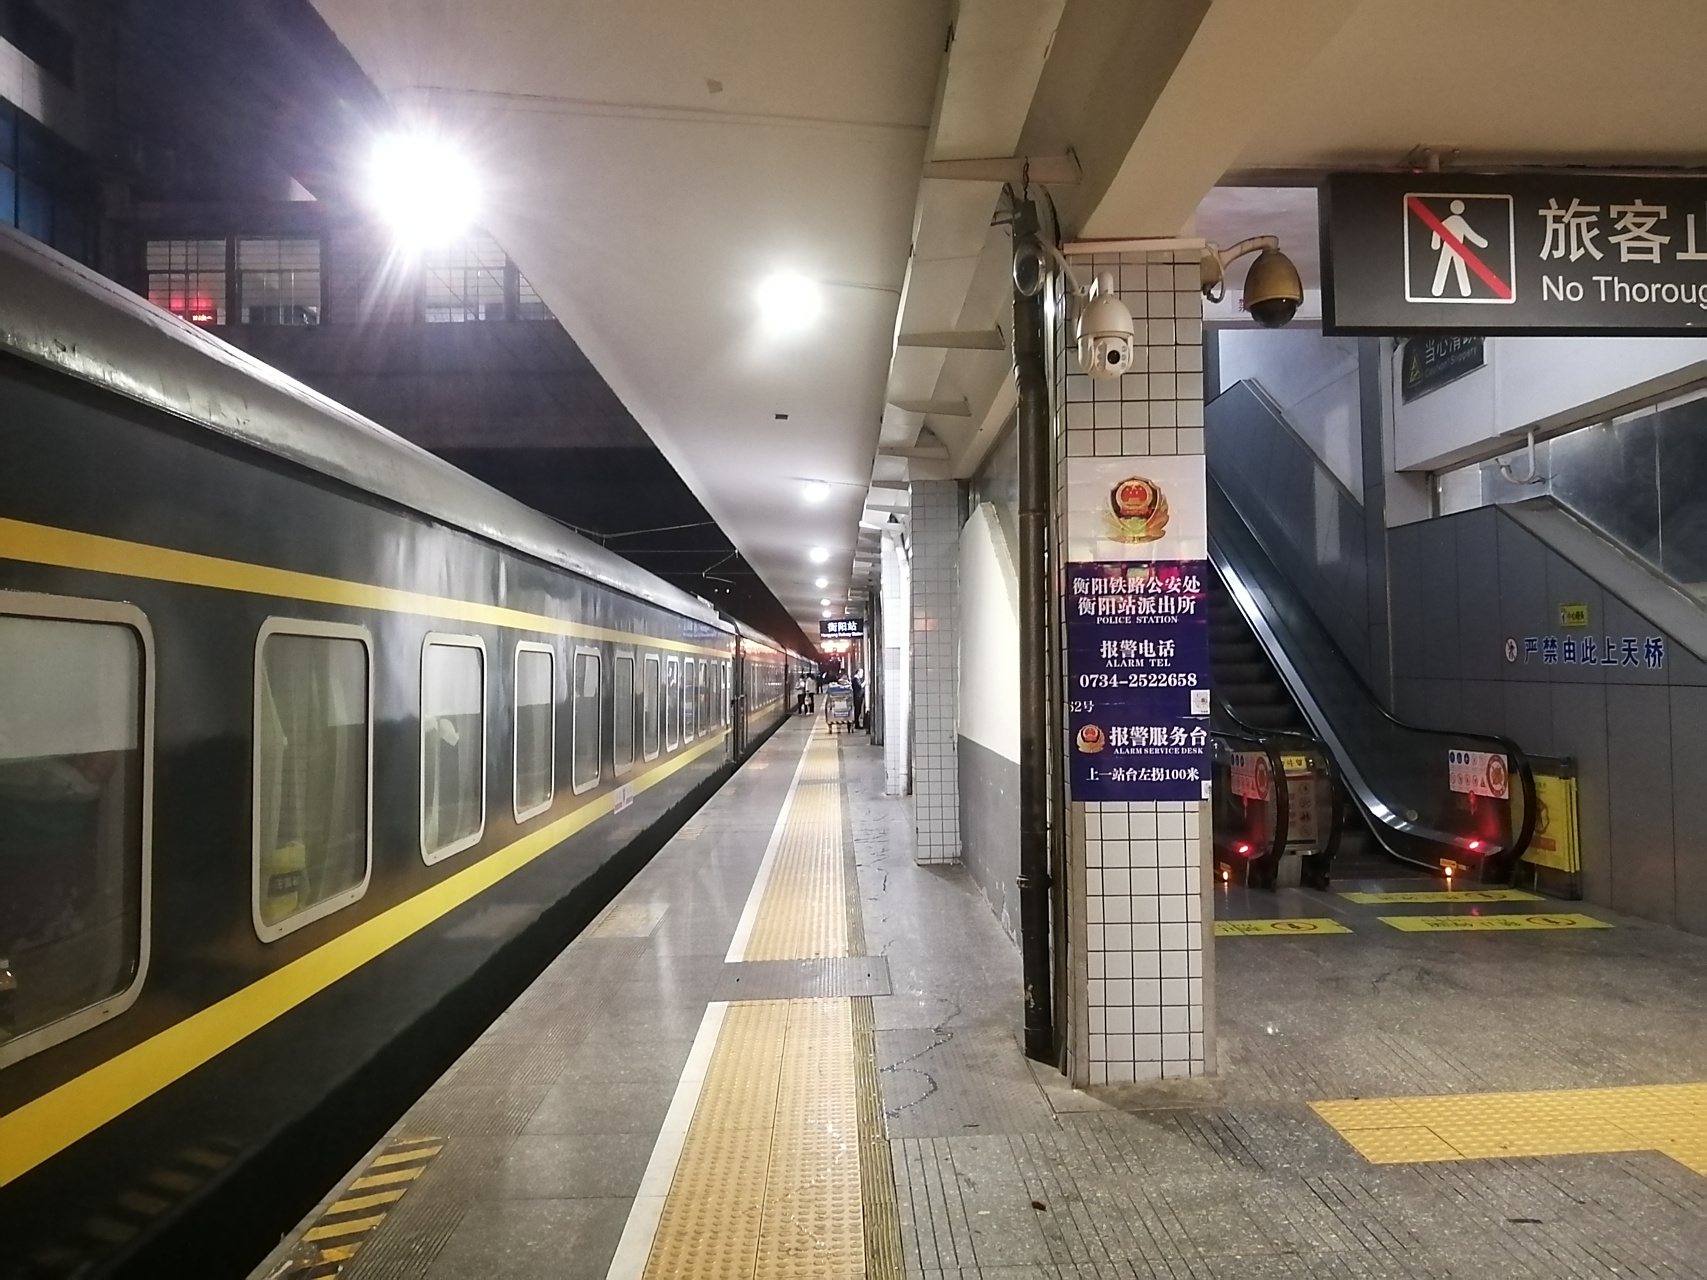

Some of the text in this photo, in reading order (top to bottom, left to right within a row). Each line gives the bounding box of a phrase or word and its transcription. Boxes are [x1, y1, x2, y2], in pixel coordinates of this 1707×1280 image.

[1541, 275, 1584, 302] No
[1072, 575, 1201, 595] 衡阳铁路公安处
[1078, 596, 1196, 615] 衡阳站派出所
[827, 621, 857, 632] 衡阳站
[1096, 615, 1178, 624] POLICE STATION
[1100, 639, 1175, 658] 报警电话
[1524, 635, 1665, 670] 严禁由此上天桥
[1106, 658, 1171, 667] ALARM TEL
[1079, 673, 1197, 688] 0734-2522658
[1109, 726, 1208, 747] 报警服务台
[1113, 747, 1204, 755] ALARM SERVICE DESK
[1085, 767, 1200, 782] 上一站台左拐100米
